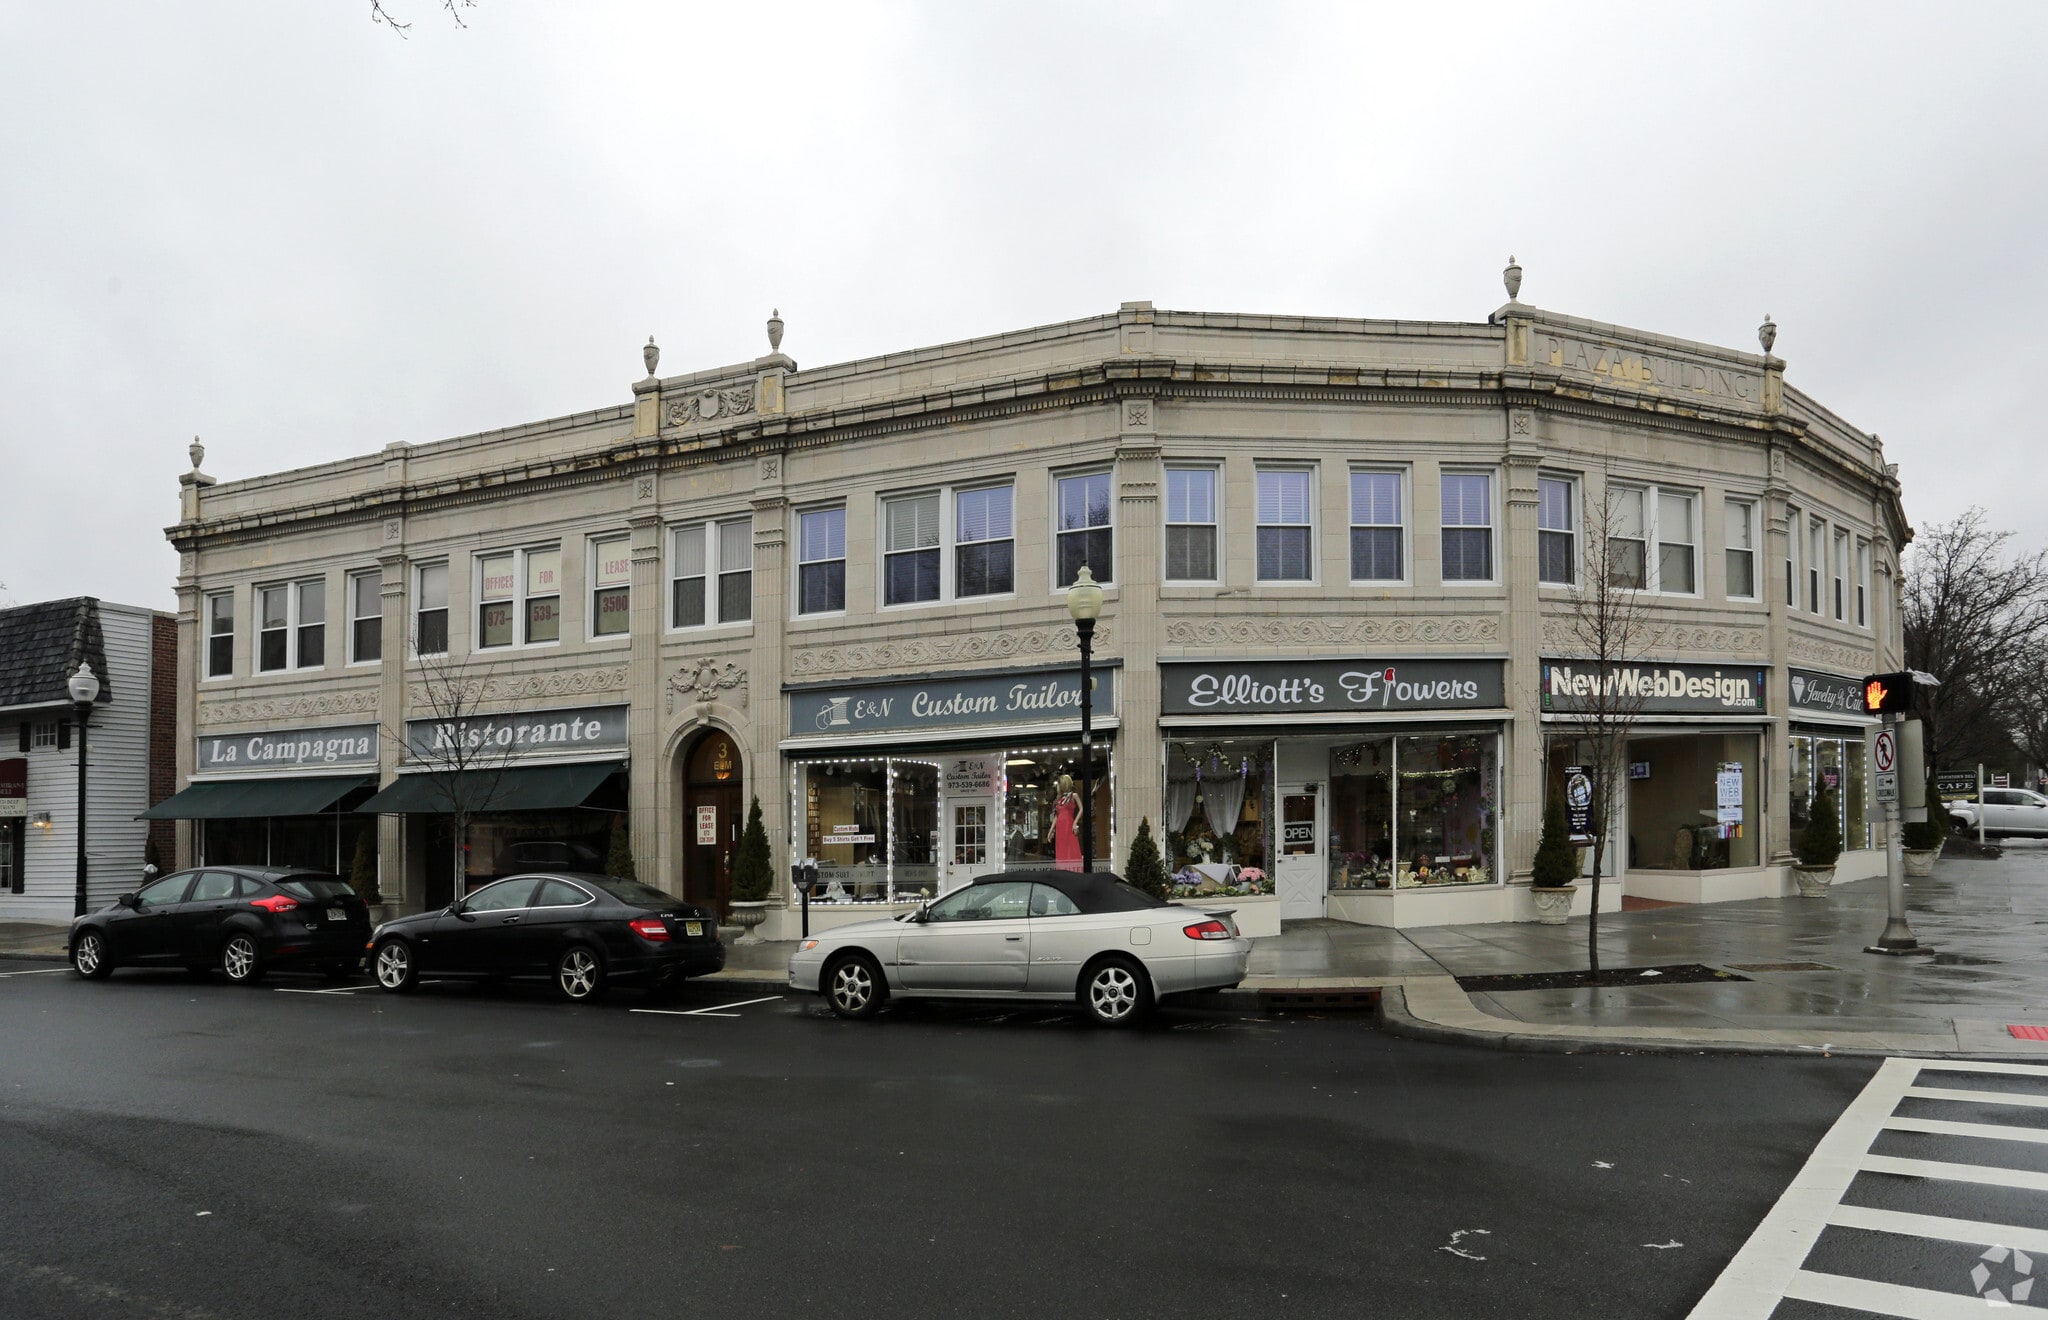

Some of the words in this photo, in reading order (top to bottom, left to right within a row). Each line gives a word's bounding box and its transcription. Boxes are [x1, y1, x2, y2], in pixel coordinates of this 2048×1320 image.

[1548, 338, 1626, 377] PLAZA
[1641, 356, 1748, 398] BUILDING
[485, 575, 514, 591] OFFICES
[539, 570, 554, 584] FOR
[605, 558, 629, 575] LEASE
[603, 595, 628, 613] 3500
[1188, 674, 1325, 707] Elliott's
[1803, 679, 1836, 710] Jewelry
[854, 698, 894, 719] E&N
[911, 691, 998, 718] Custom
[432, 717, 602, 750] Ristorante
[210, 740, 237, 763] La
[246, 737, 369, 763] Campagna
[718, 742, 728, 759] 3
[713, 760, 732, 770] ELM
[971, 771, 991, 780] Tailor
[1720, 778, 1739, 787] NEW
[1720, 788, 1739, 797] WEB
[1937, 782, 1973, 790] CAFE
[700, 822, 714, 830] LEASE
[1284, 827, 1314, 839] OPEN
